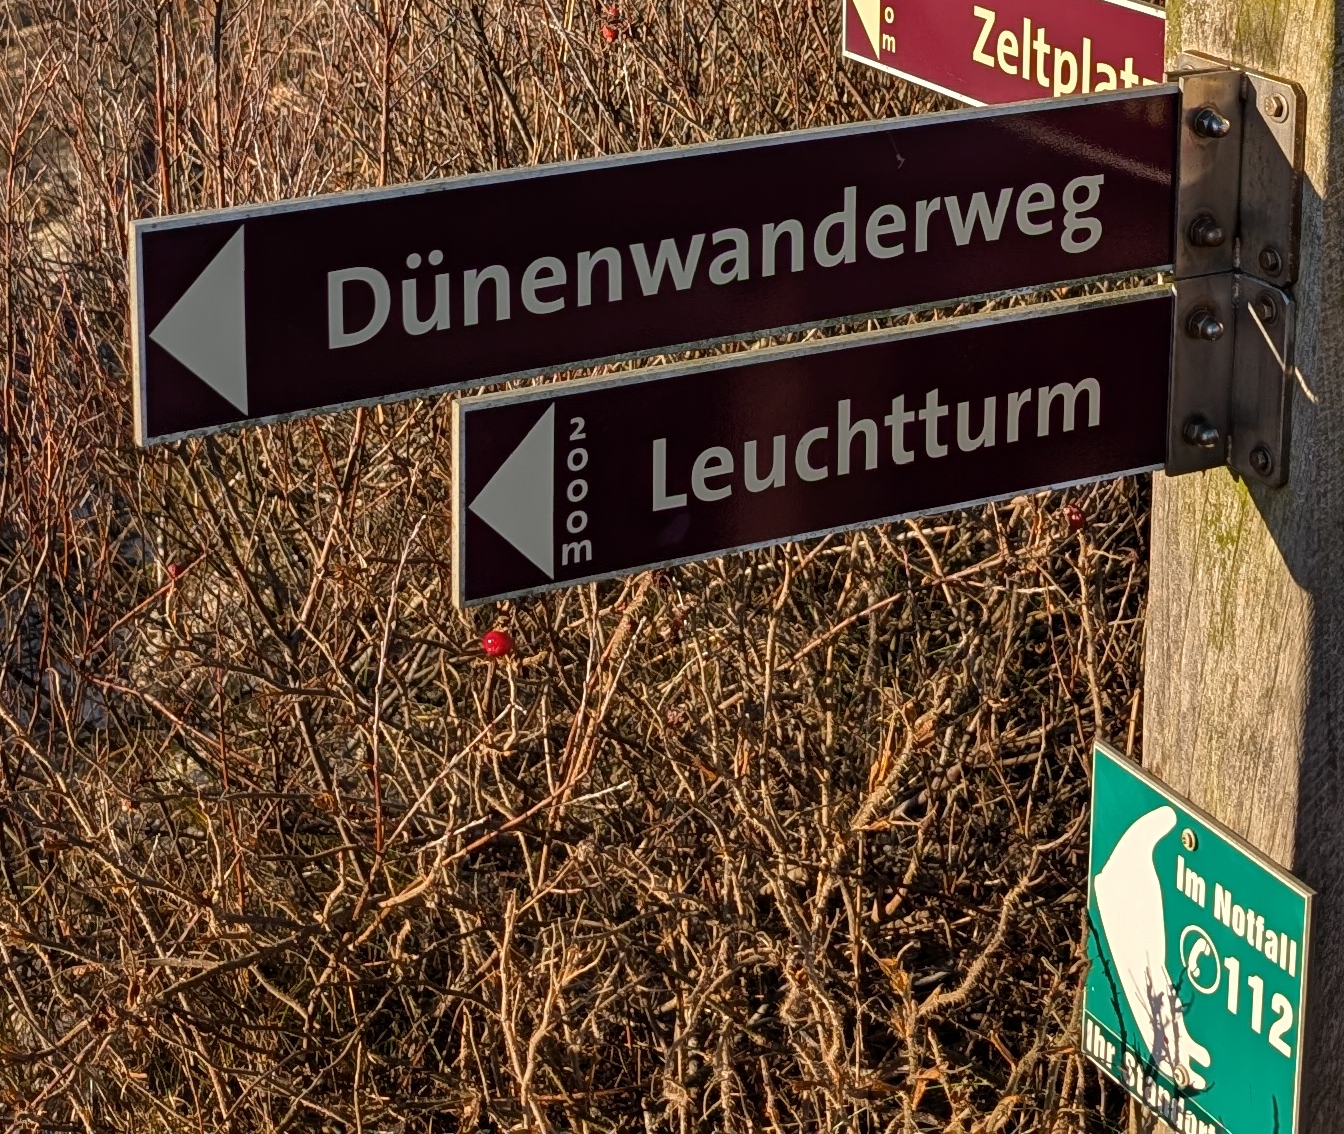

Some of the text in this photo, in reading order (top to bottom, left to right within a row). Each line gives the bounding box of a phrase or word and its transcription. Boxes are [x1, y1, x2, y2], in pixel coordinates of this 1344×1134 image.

[972, 5, 1159, 98] Zeltplat
[327, 172, 1105, 350] Dünenwanderweg
[652, 376, 1102, 514] Leuchtturm
[1176, 854, 1297, 978] Im Notfall
[1086, 1018, 1116, 1069] Ihr
[1224, 956, 1294, 1058] 112
